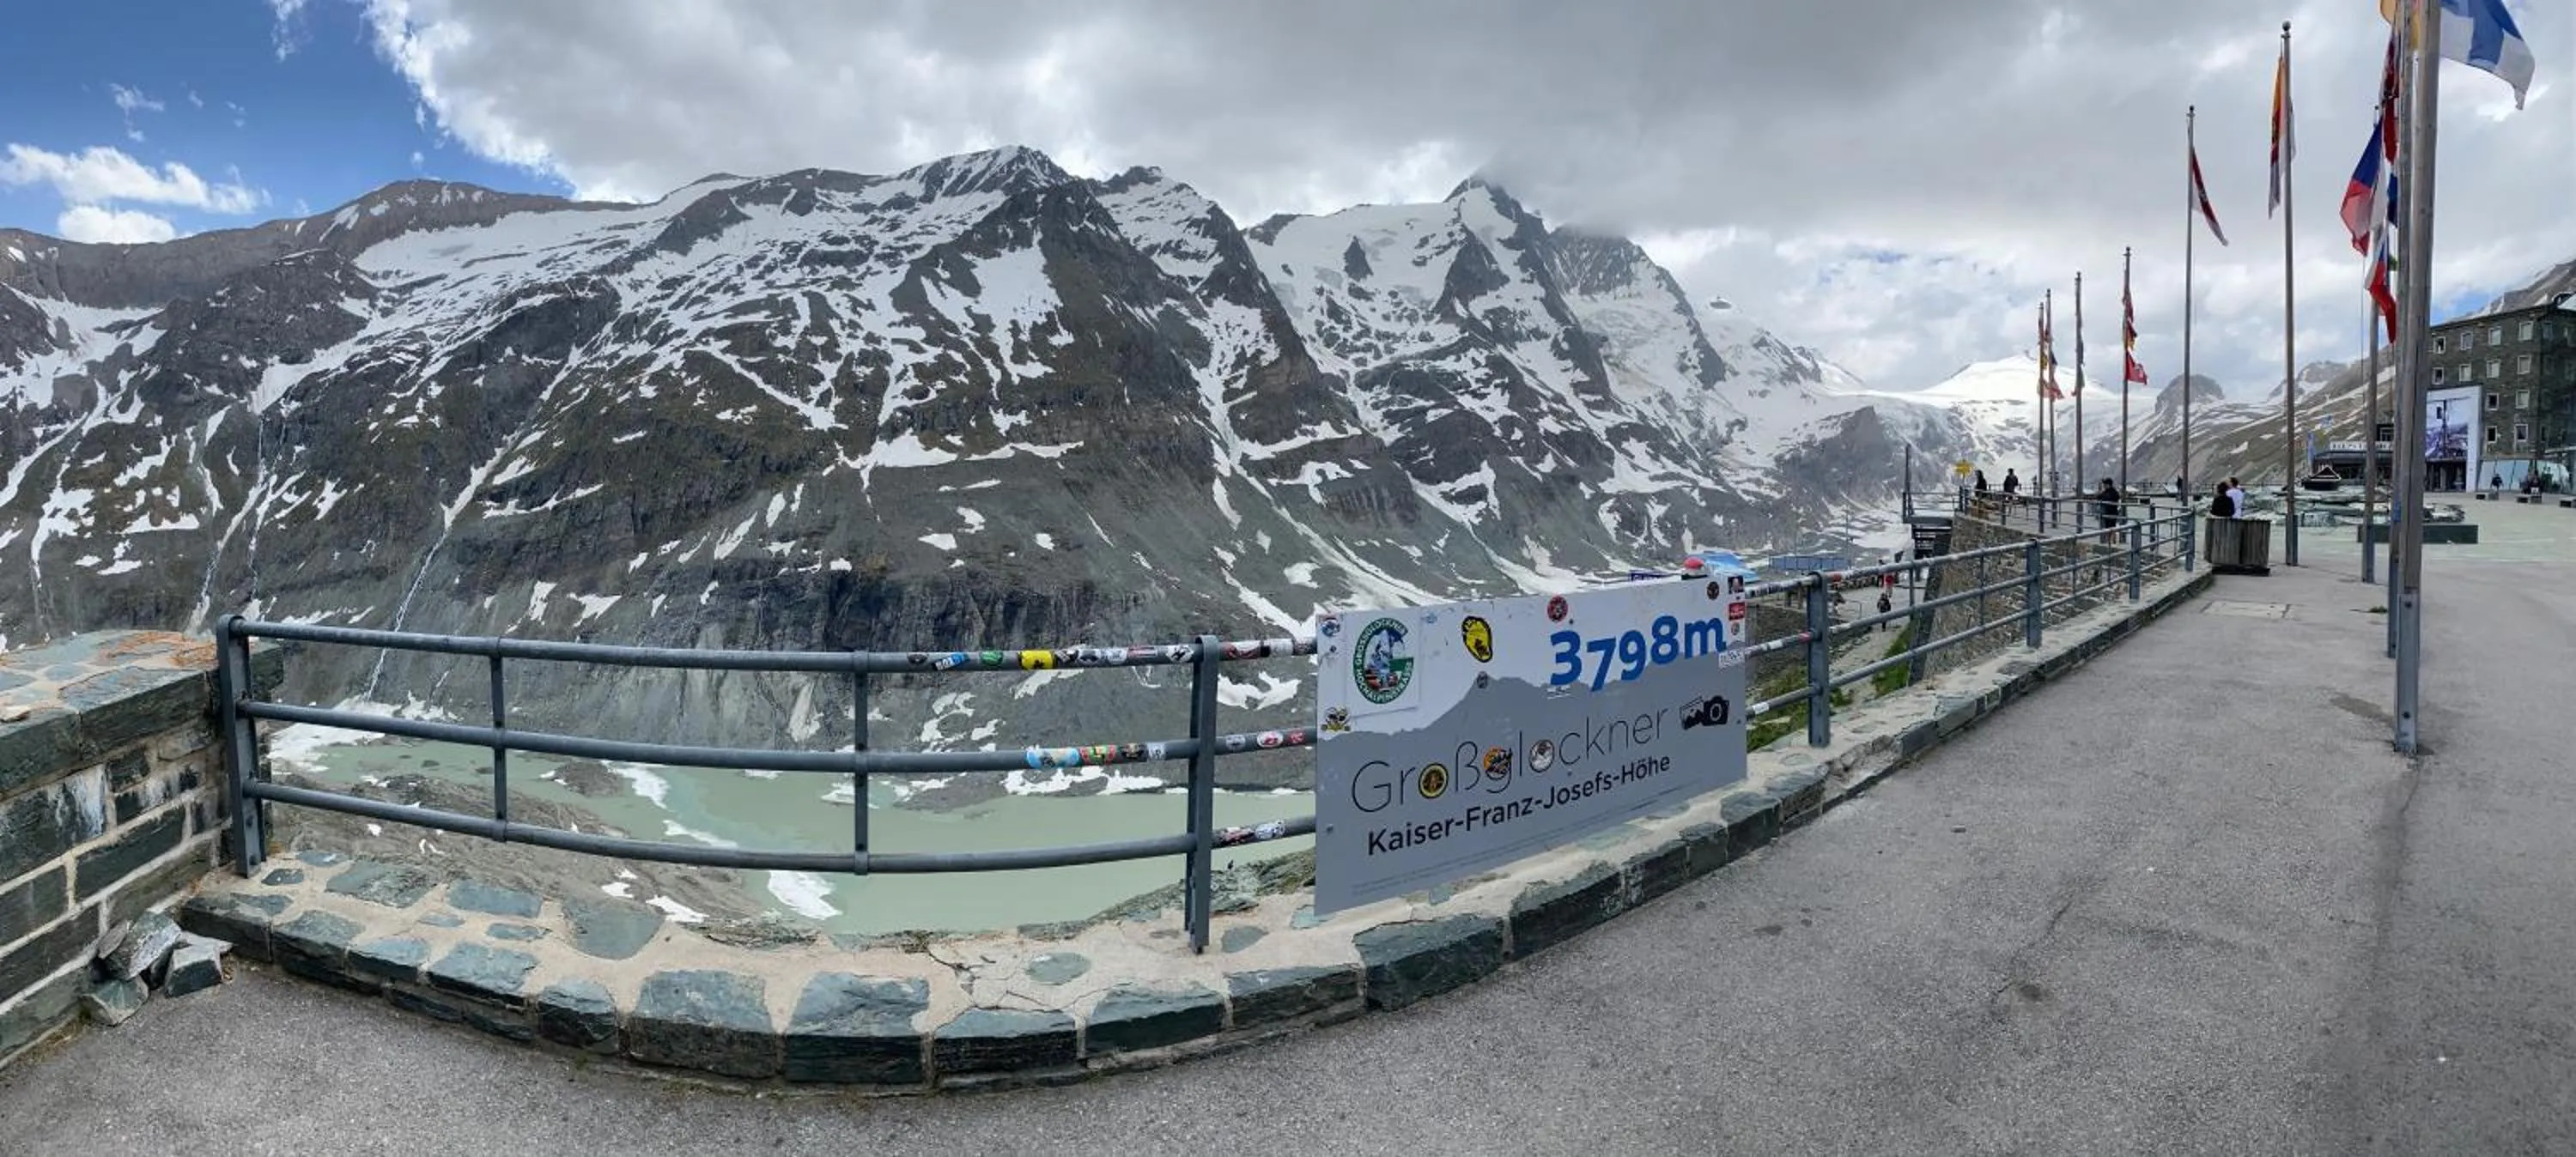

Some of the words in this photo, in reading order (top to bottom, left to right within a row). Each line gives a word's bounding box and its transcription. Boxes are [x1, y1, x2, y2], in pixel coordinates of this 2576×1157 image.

[1550, 615, 1727, 692] 3798m
[1352, 706, 1668, 813] Großglockner
[1368, 754, 1671, 856] Kaiser-Franz-Josefs-Höhe
